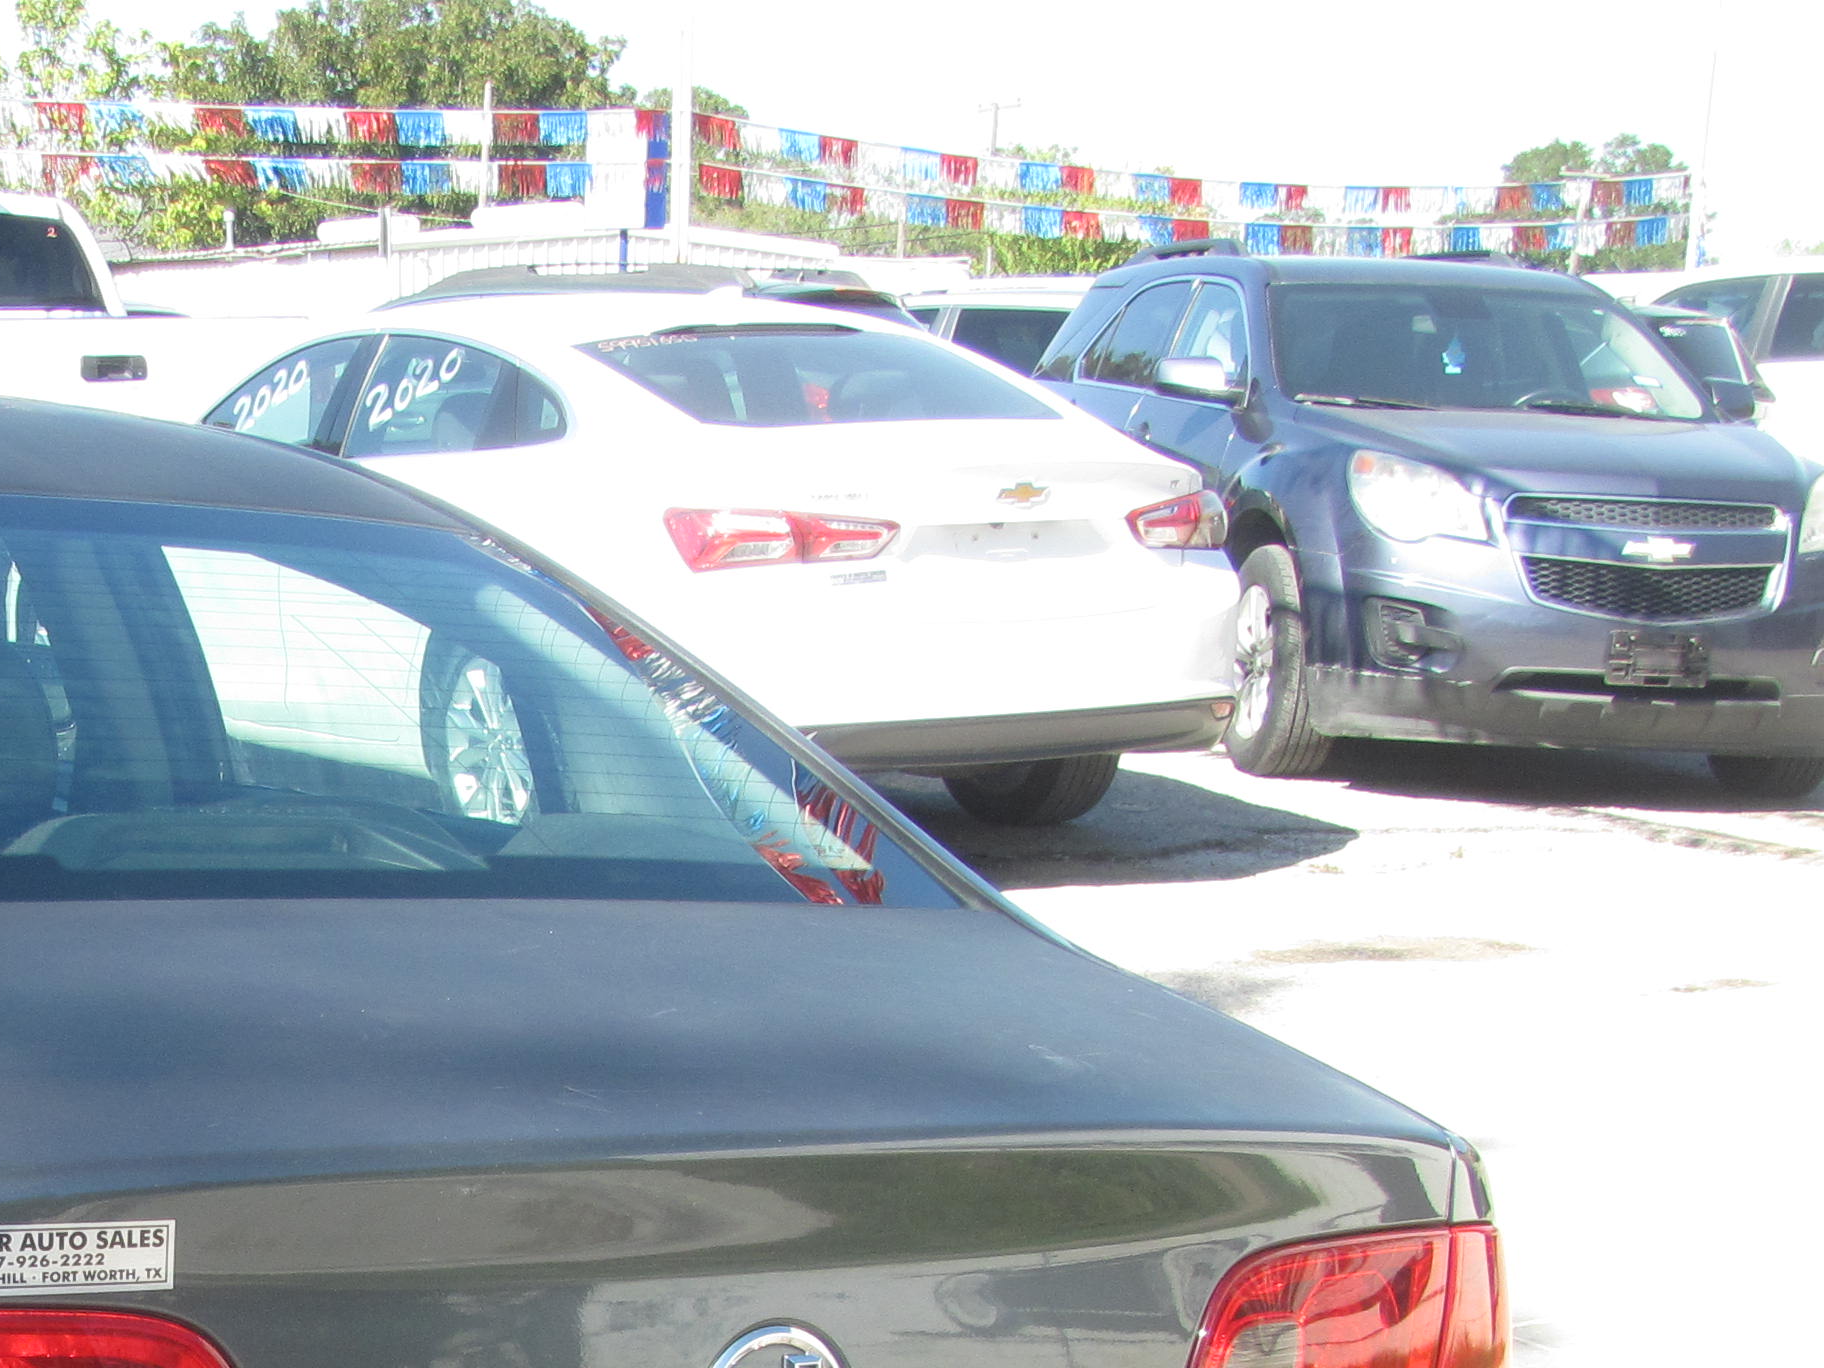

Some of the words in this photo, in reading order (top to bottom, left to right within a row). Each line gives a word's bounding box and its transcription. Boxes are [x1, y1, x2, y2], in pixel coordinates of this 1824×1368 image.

[233, 359, 309, 432] 2020
[365, 347, 464, 432] 2020
[19, 1231, 87, 1252] AUTO
[96, 1229, 165, 1249] SALES
[42, 1270, 77, 1284] FORT
[83, 1268, 139, 1283] WORTH,
[145, 1267, 162, 1279] TX
